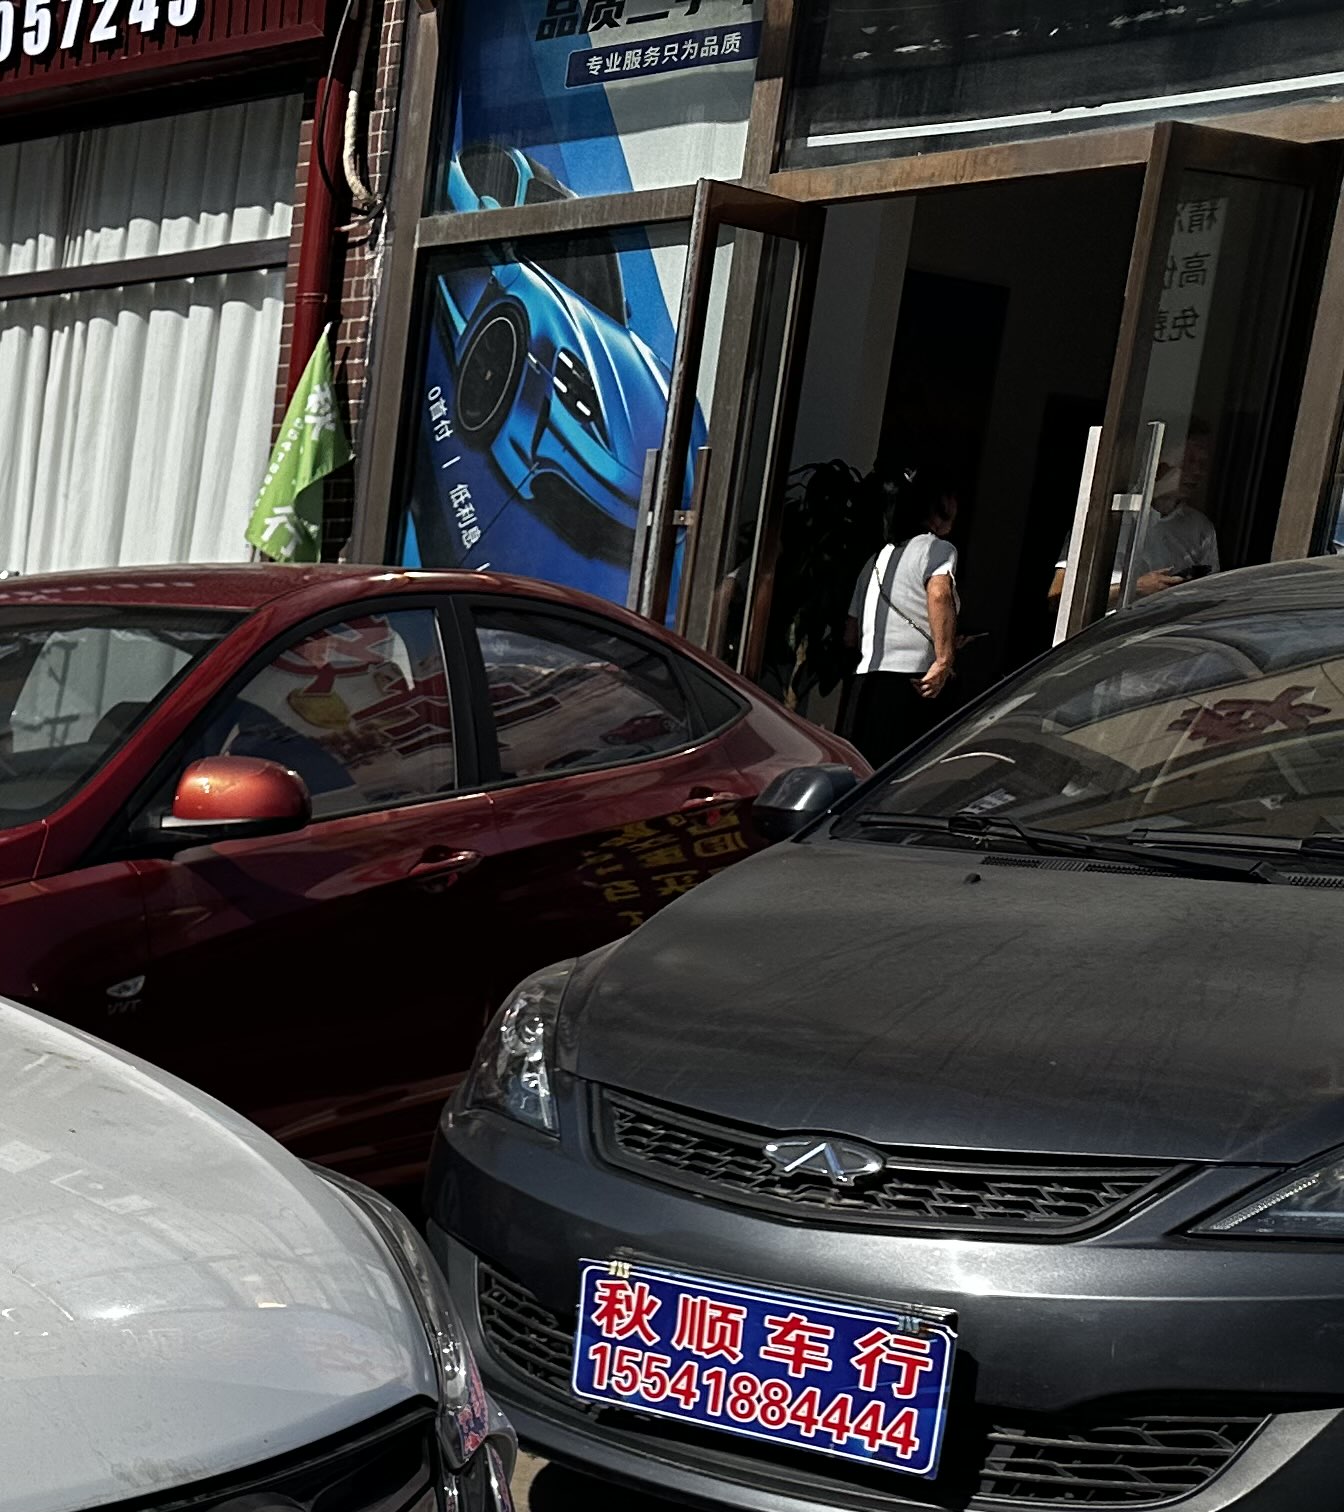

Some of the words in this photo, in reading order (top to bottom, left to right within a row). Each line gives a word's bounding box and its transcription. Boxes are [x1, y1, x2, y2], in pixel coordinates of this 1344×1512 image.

[585, 31, 743, 77] 专业服务只为品质
[427, 386, 454, 443] 0首付
[449, 483, 483, 550] 低利息
[591, 1278, 934, 1399] 秋顺车行
[587, 1341, 921, 1460] 15541884444
